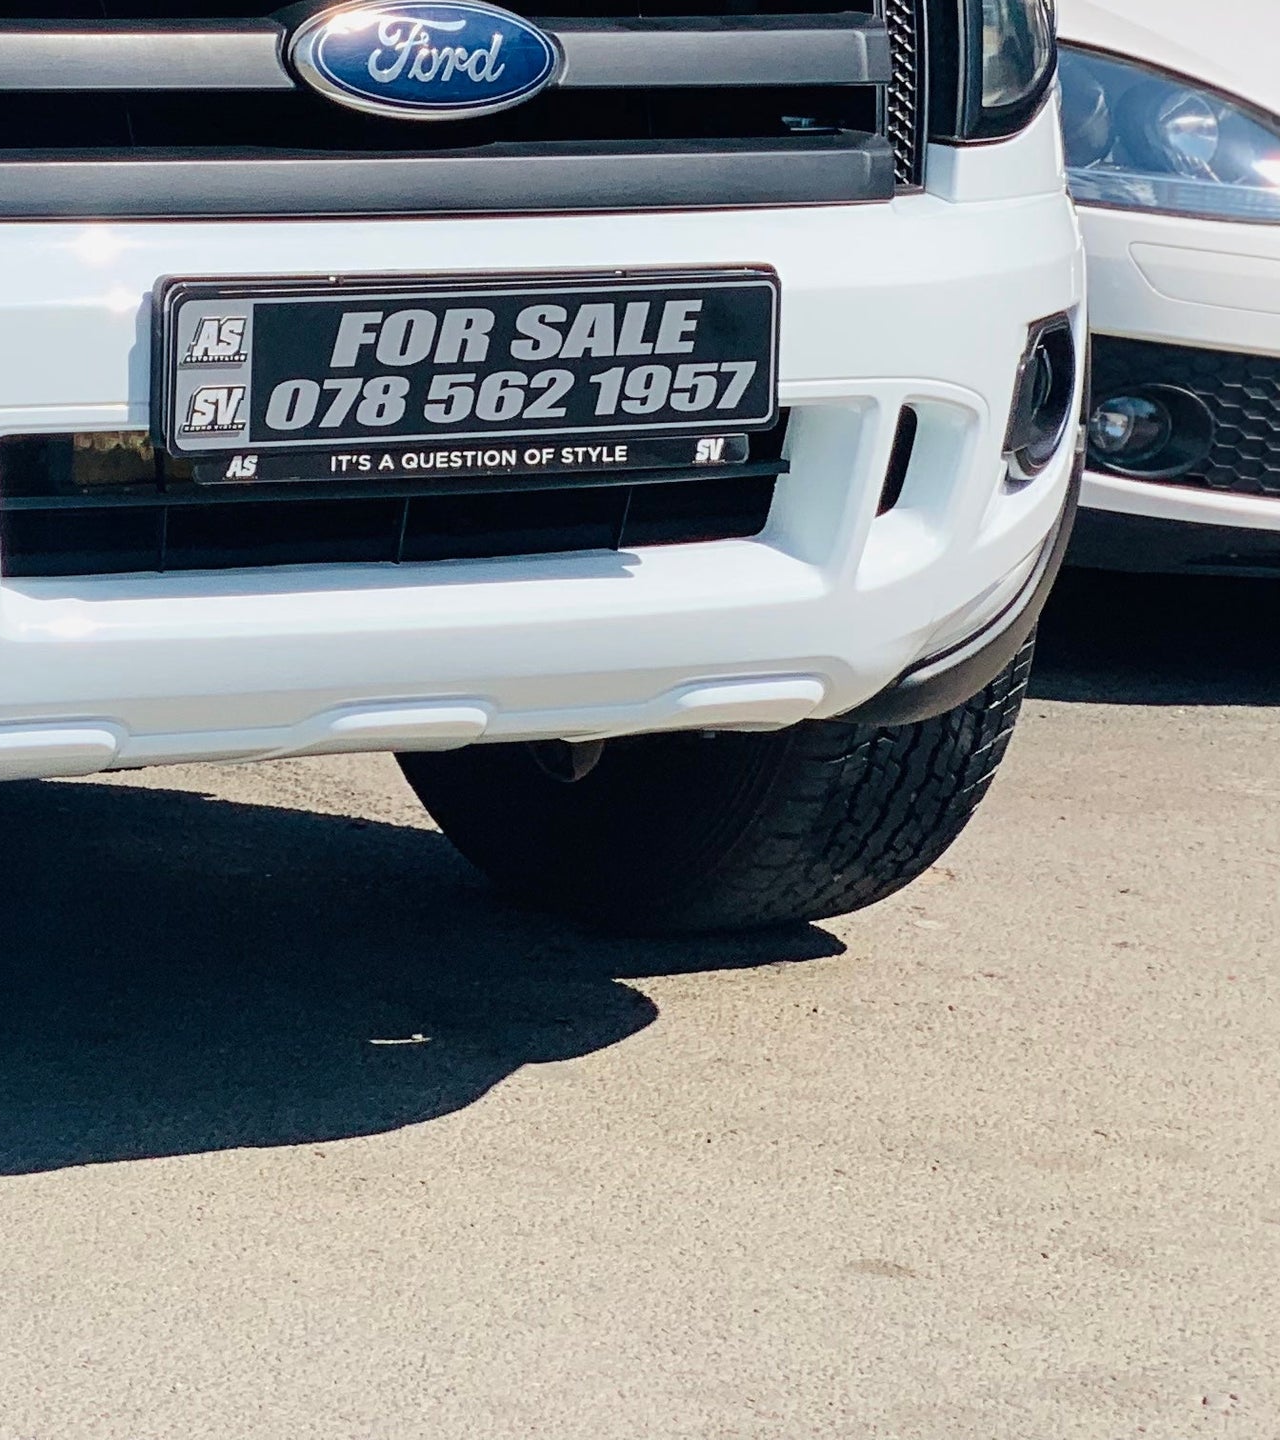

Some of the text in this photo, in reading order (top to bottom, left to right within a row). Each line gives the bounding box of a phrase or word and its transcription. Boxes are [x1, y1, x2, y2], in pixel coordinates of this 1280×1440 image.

[368, 13, 506, 83] Ford
[192, 317, 247, 357] AS
[329, 299, 703, 368] FOR SALE
[191, 388, 246, 426] SV
[264, 361, 757, 431] 078 562 1957
[225, 455, 259, 478] AS
[330, 445, 628, 472] IT'S A QUESTION OF STYLE
[695, 438, 725, 461] SV
